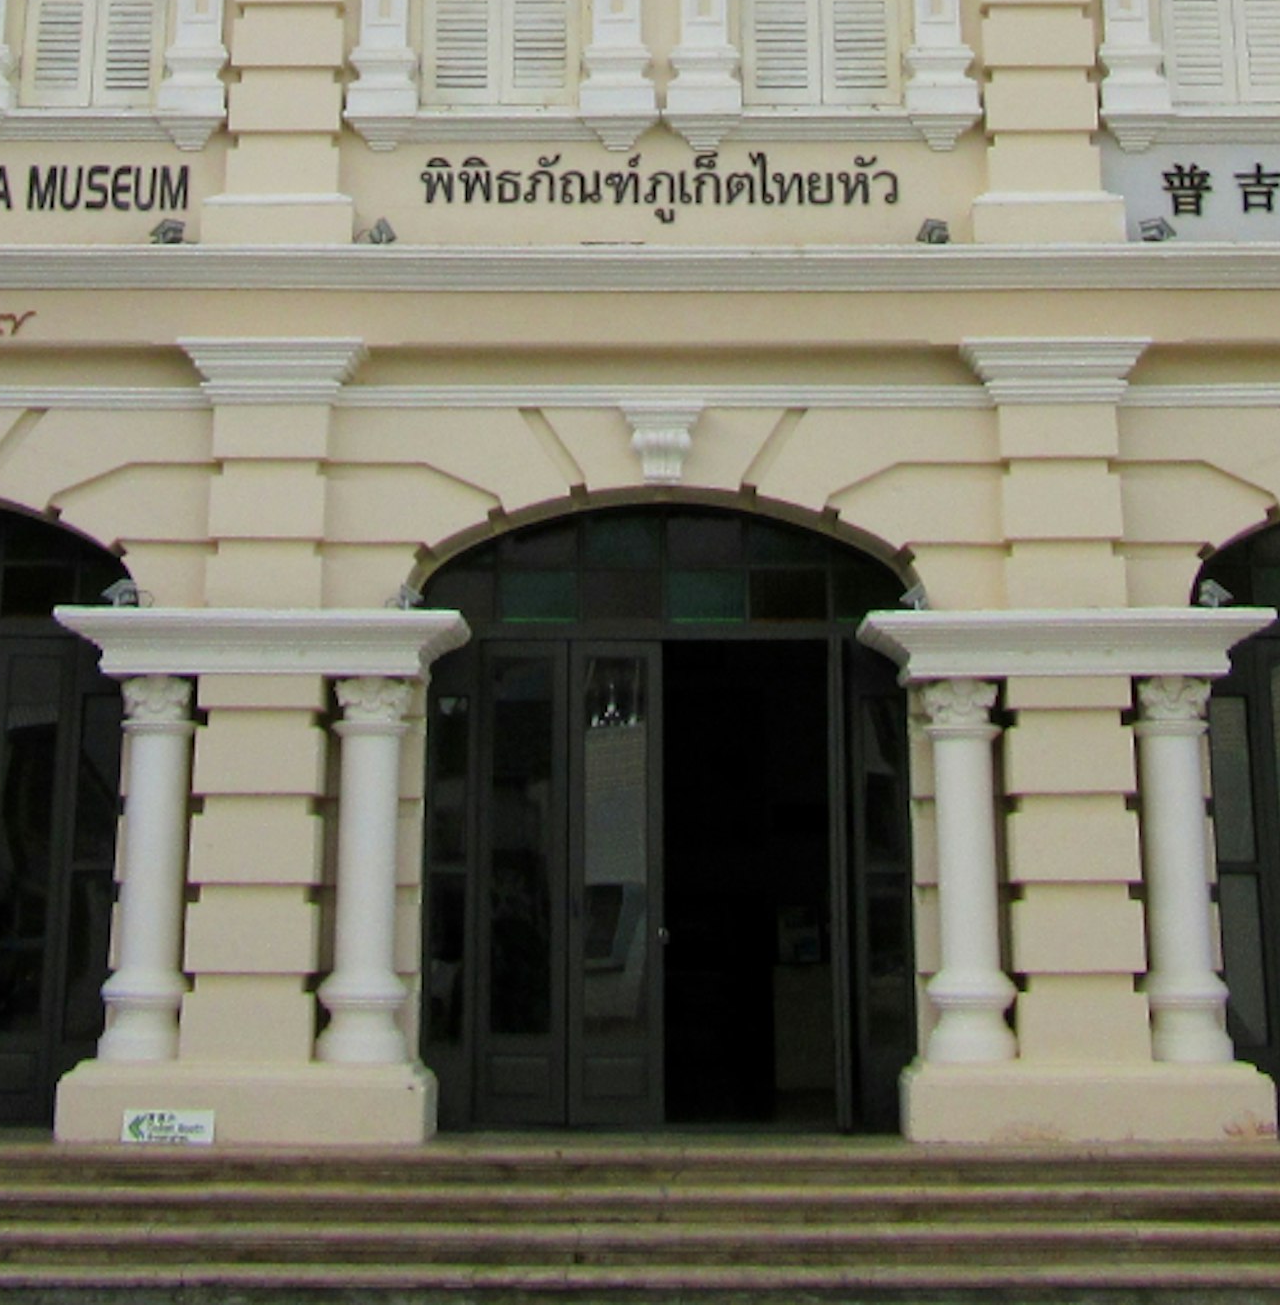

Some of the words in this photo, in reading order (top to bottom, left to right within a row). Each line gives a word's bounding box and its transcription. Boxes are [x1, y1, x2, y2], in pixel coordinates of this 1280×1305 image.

[27, 165, 189, 211] MUSEUM
[421, 151, 898, 223] พิพิธภัณฑ์ภูเก็ตไทยหัว
